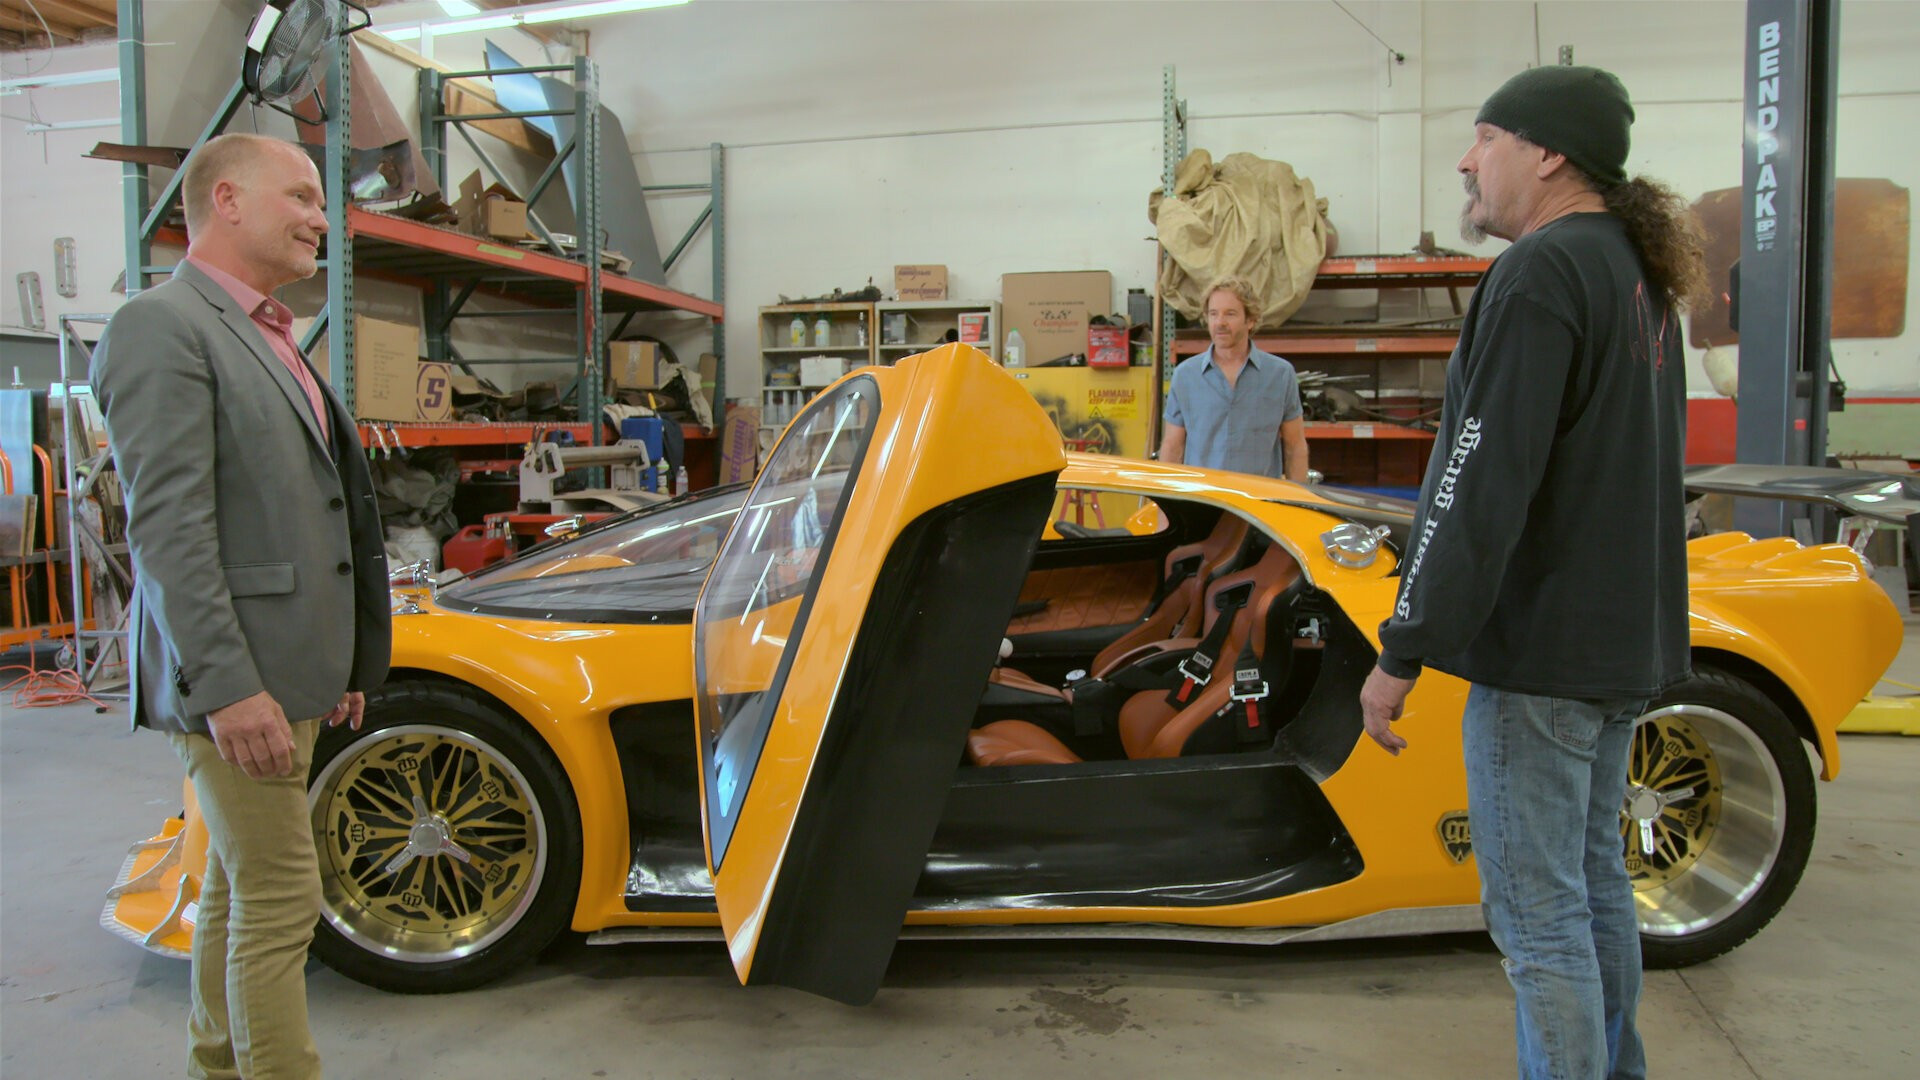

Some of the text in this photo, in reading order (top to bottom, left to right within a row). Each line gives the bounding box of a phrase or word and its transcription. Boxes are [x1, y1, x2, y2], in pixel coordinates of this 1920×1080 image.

[1755, 21, 1781, 218] BENDPAK
[424, 377, 445, 408] S
[1088, 389, 1135, 398] FLAMMABLE
[1434, 416, 1482, 510] garage
